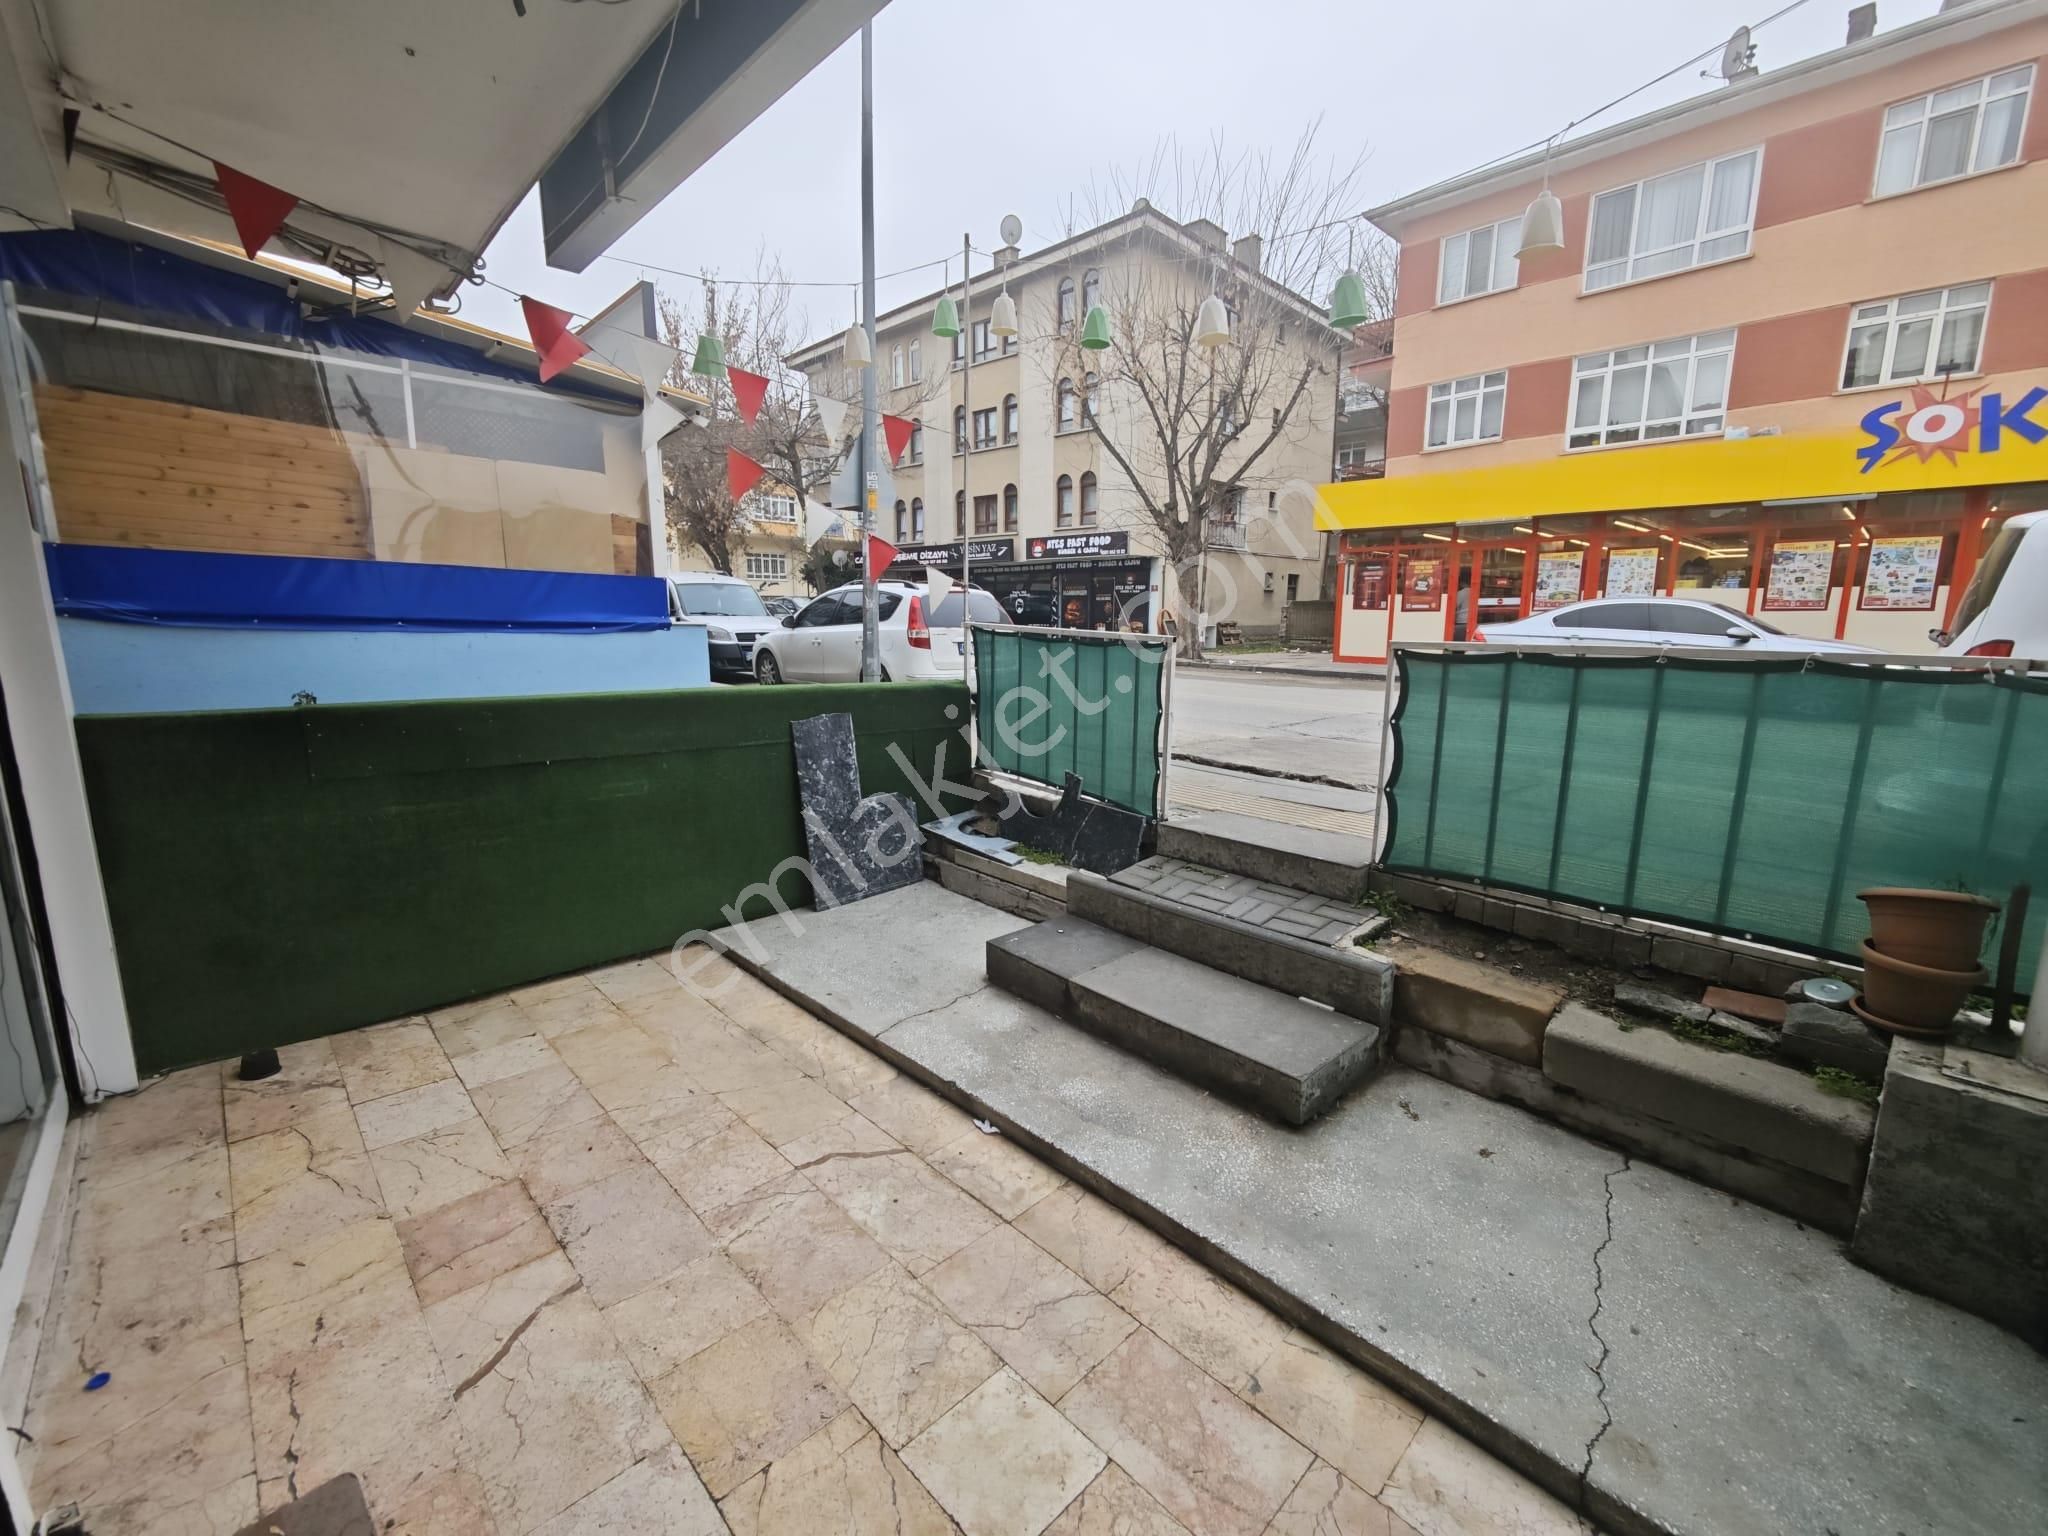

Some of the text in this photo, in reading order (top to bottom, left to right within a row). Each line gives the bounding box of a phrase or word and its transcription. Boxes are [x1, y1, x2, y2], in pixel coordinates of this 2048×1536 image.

[1856, 386, 2048, 474] ŞOK
[1067, 537, 1086, 548] FAST
[1089, 535, 1111, 546] FOOD
[982, 543, 997, 553] YAZ
[920, 550, 948, 559] DİZAYN
